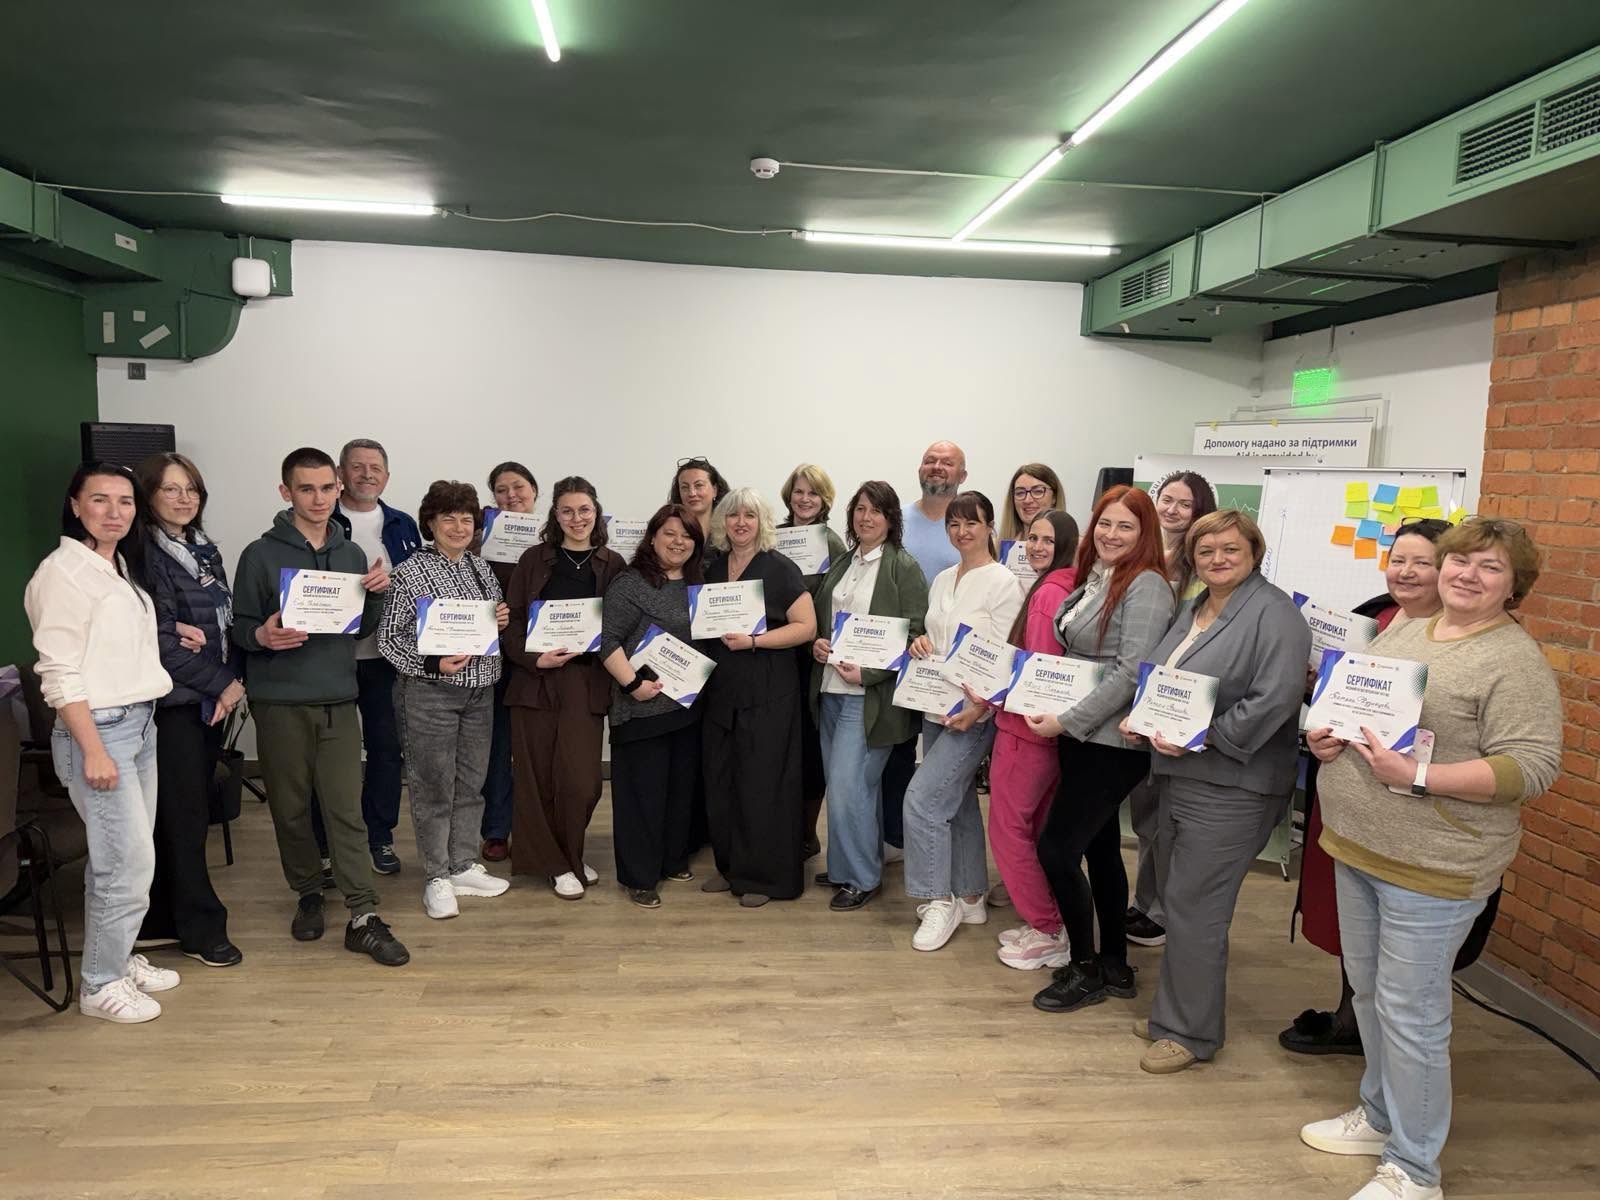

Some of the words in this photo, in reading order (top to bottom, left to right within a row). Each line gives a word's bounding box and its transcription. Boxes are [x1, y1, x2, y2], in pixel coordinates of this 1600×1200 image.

[1204, 438, 1249, 450] Допомогу
[1251, 438, 1286, 449] надано
[1288, 438, 1300, 448] за
[1301, 436, 1358, 449] підтримки
[503, 523, 537, 533] СЕРТИФІКАТ
[302, 585, 341, 595] СЕРТИФІКАТ
[439, 612, 475, 621] СЕРТИФІКАТ
[549, 612, 582, 620] СЕРТИФІКАТ
[853, 626, 887, 637] СЕРТИФІКАТ
[1309, 616, 1348, 638] СЕРТИФІКАТ
[1035, 668, 1075, 684] СЕРТИФІКАТ
[1346, 674, 1393, 692] СЕРТИФІКАТ
[1157, 683, 1192, 700] СЕРТИФІКАТ
